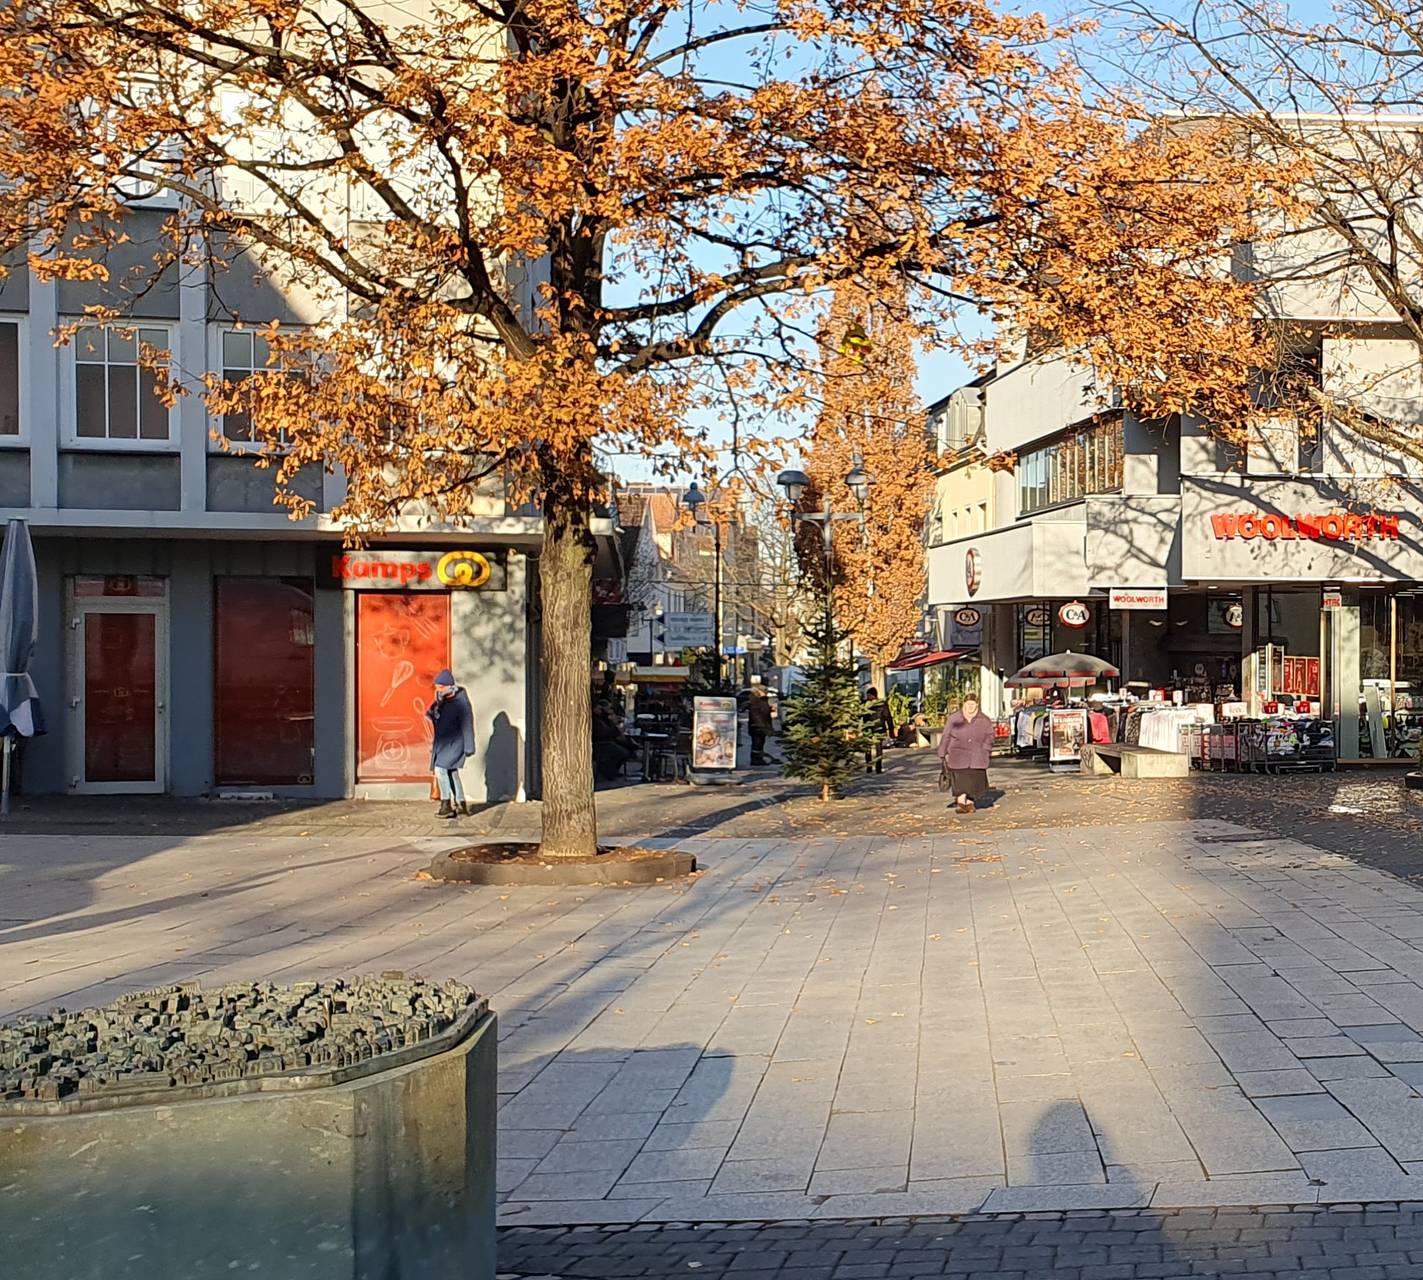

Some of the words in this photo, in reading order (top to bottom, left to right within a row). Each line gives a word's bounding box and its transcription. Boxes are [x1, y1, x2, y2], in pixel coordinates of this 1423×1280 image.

[1211, 513, 1398, 540] WOOLWORTH
[331, 553, 432, 585] Kamps
[1113, 595, 1164, 603] WOOLWORTH
[1065, 608, 1087, 621] C&A
